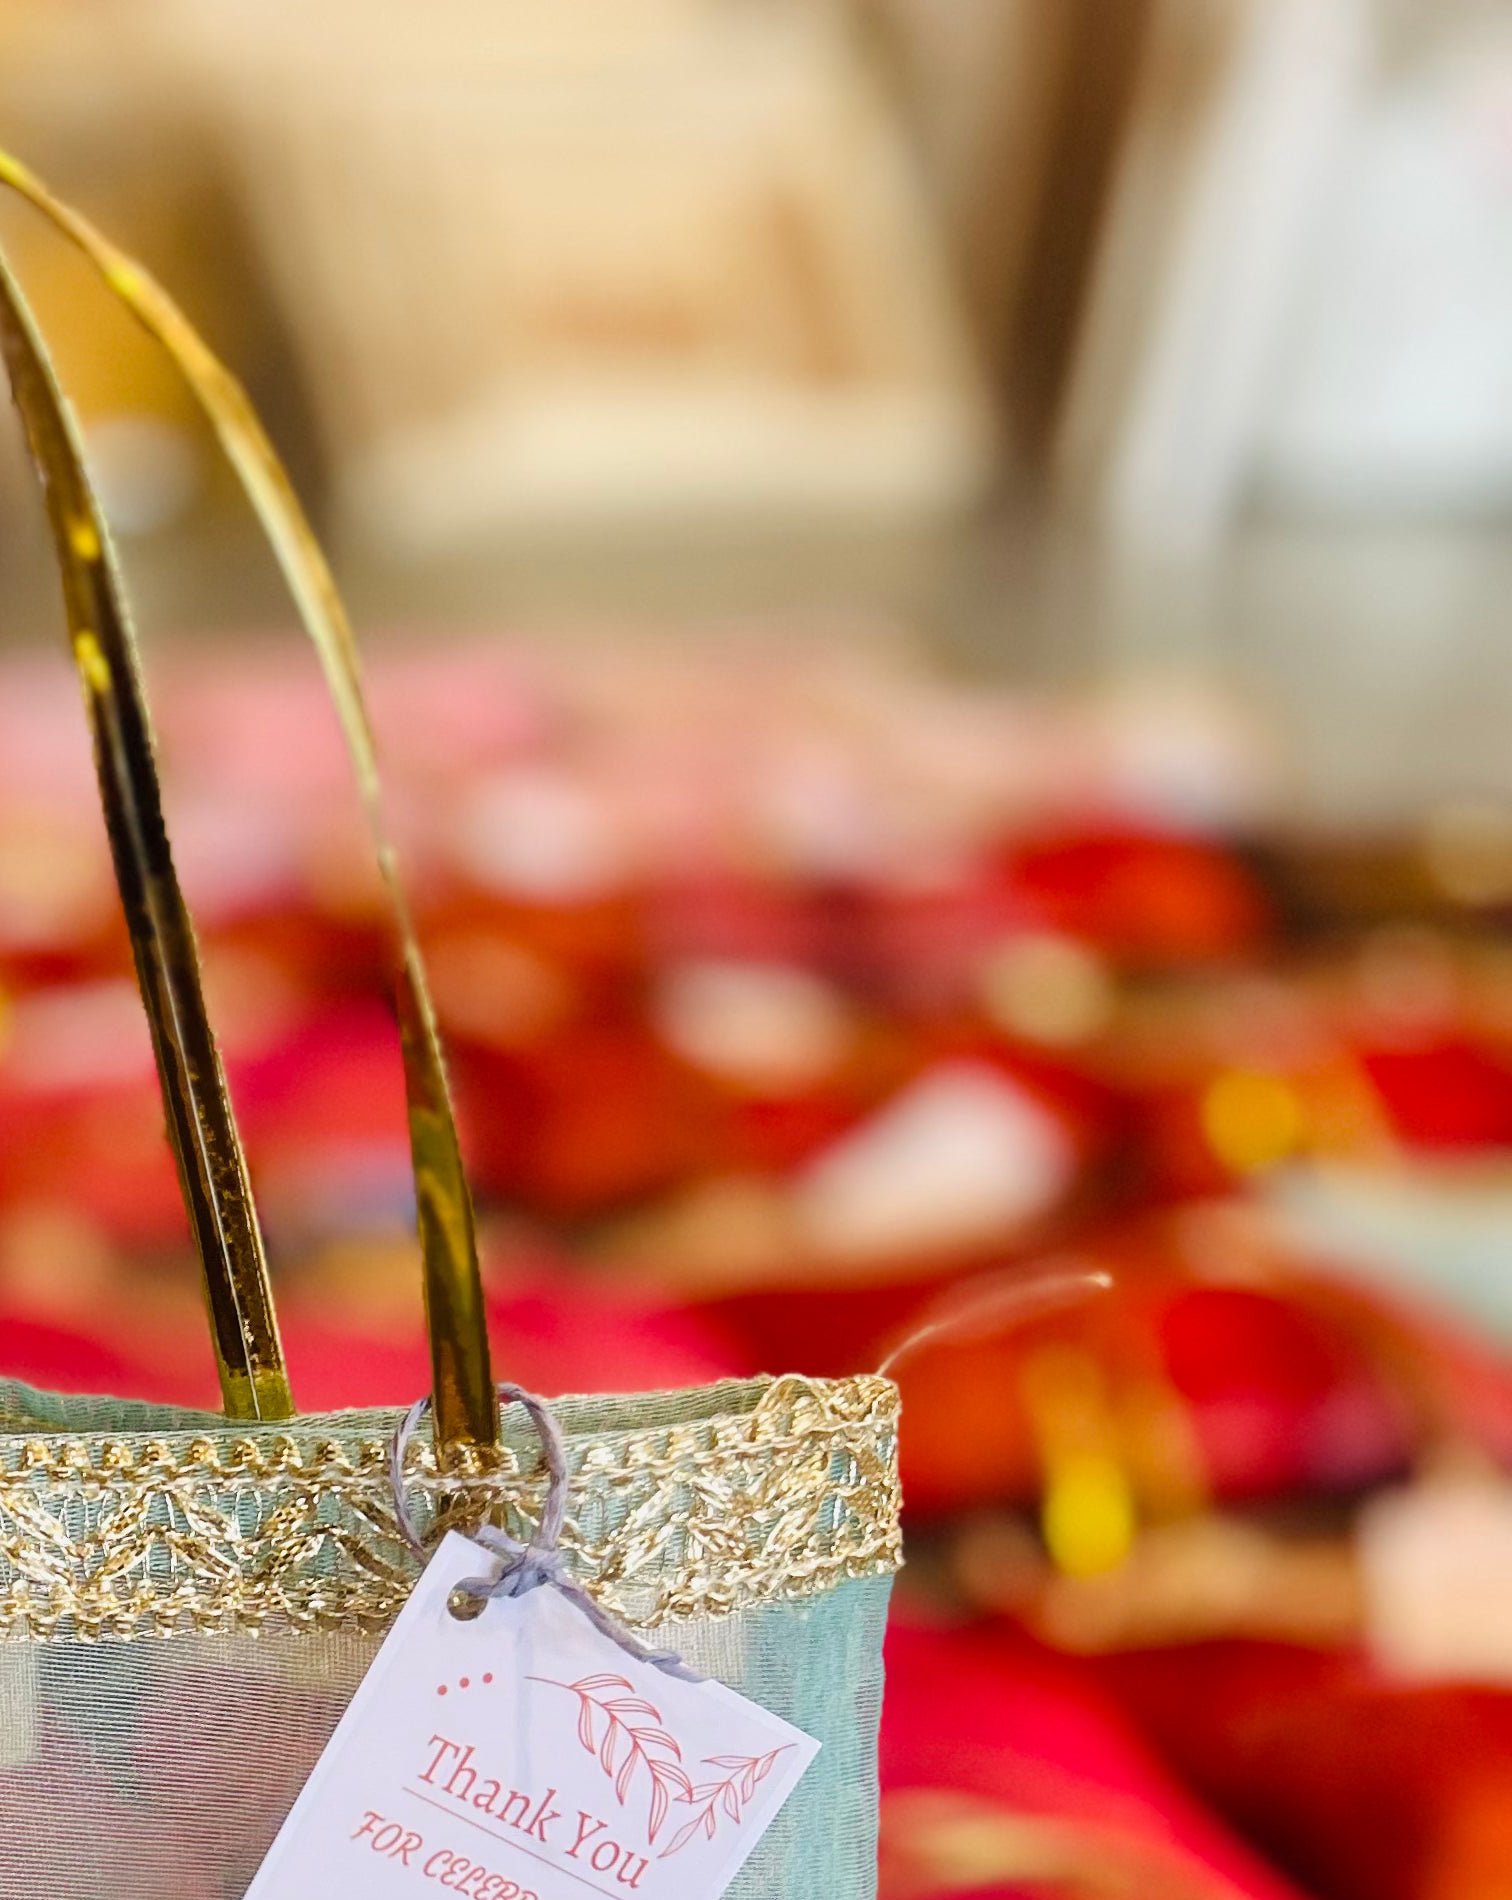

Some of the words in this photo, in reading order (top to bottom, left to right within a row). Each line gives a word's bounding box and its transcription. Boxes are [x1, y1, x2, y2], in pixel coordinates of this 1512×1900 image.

[350, 1810, 423, 1866] FOR
[417, 1733, 562, 1842] Thank
[564, 1811, 649, 1888] You
